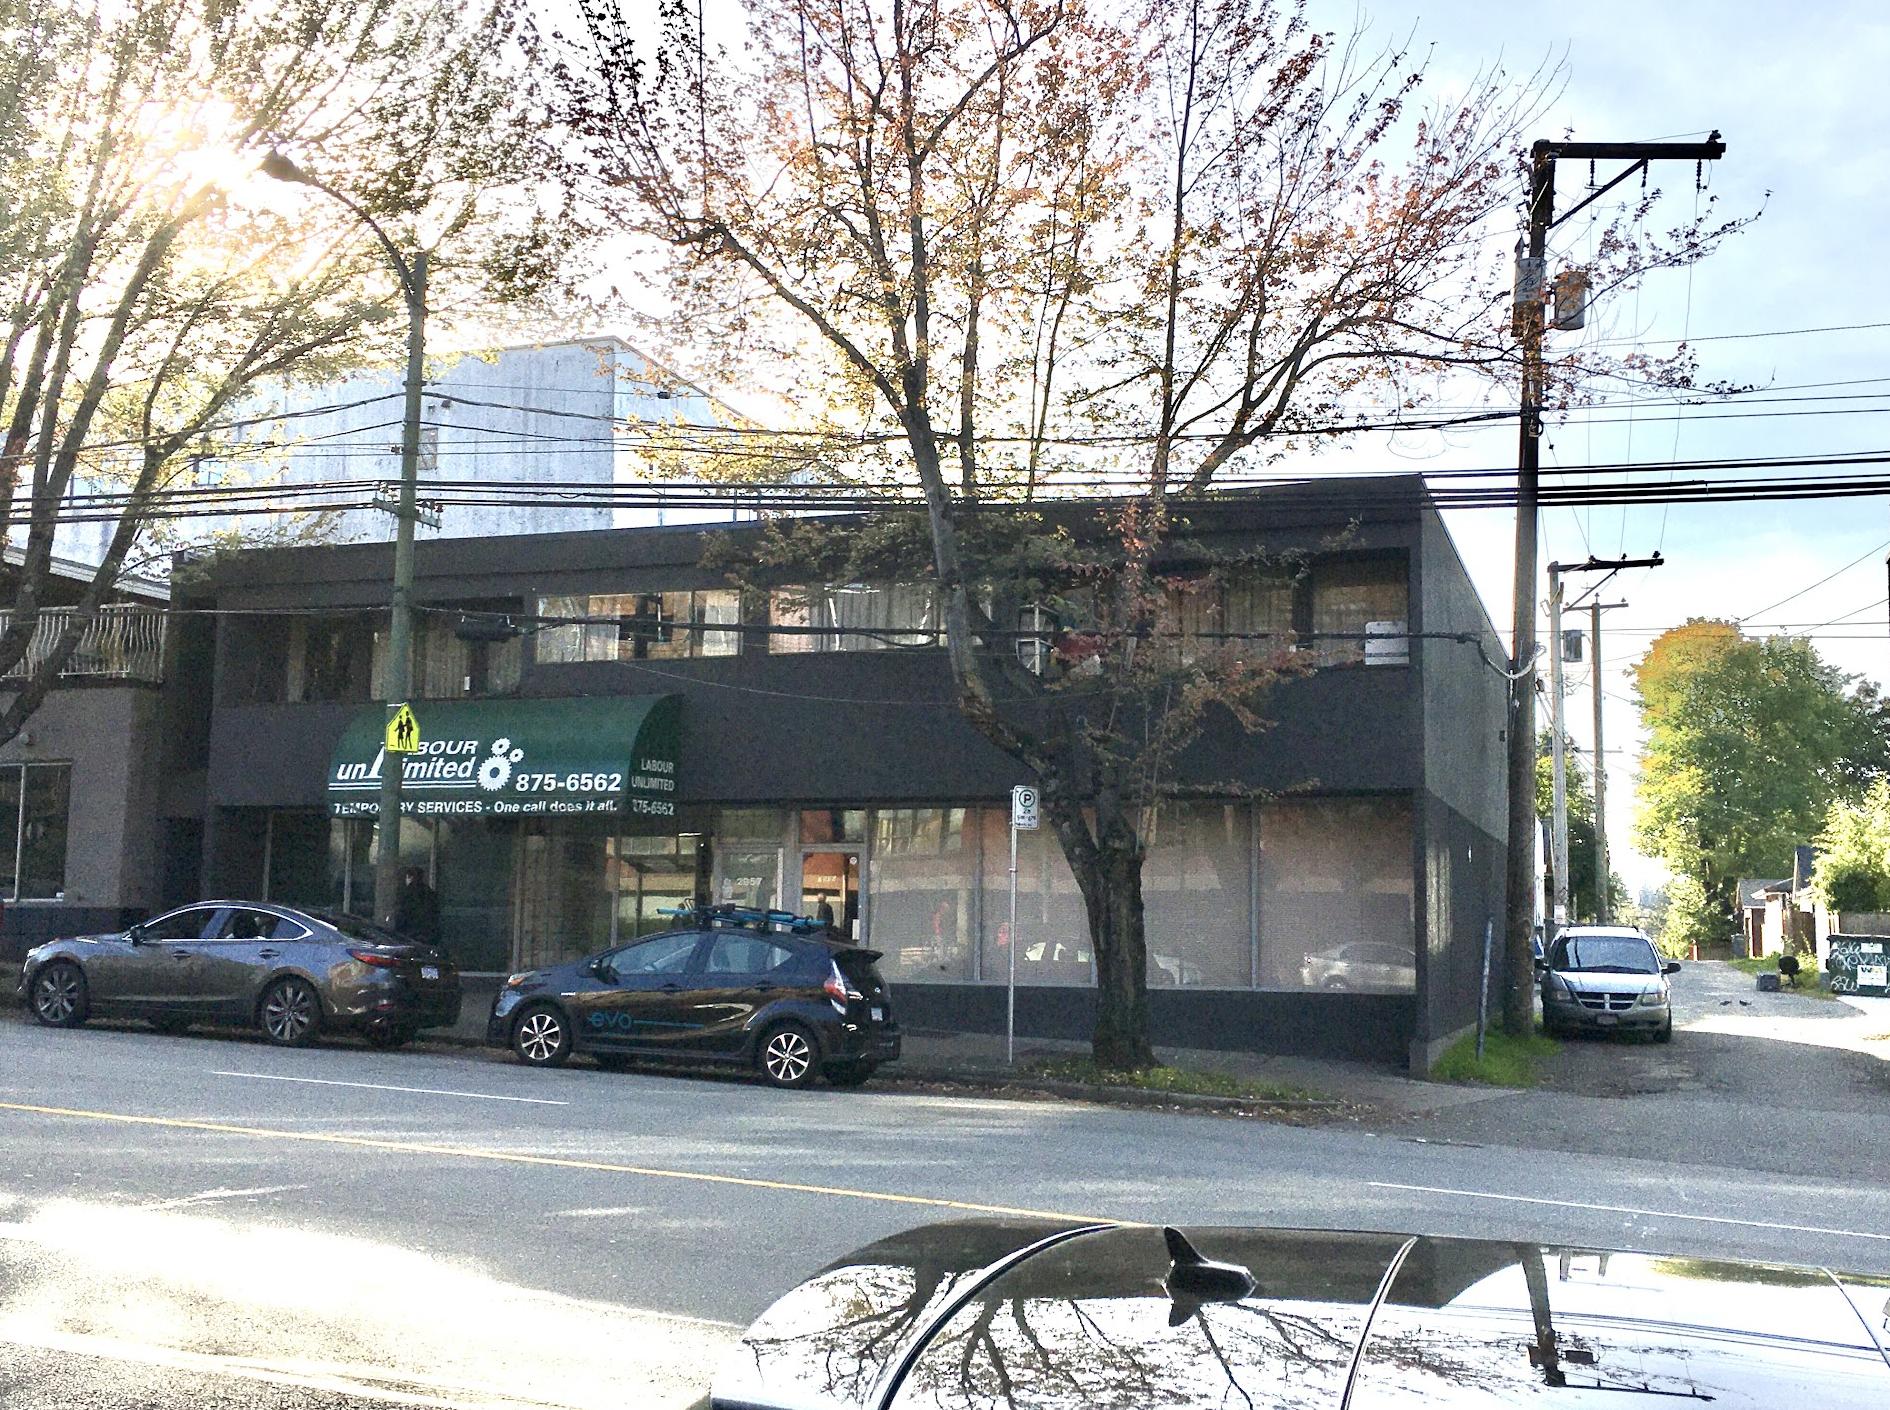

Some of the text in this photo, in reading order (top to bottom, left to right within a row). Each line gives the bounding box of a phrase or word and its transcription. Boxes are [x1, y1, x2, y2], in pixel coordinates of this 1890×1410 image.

[641, 758, 674, 774] LABOUR
[516, 773, 622, 792] 875-6562
[631, 775, 675, 791] UNLIMITED
[334, 802, 414, 814] TEMPORY
[417, 801, 483, 814] SERVICES
[493, 801, 521, 813] One
[523, 800, 546, 812] call
[550, 800, 582, 812] does
[585, 800, 594, 811] it
[588, 1011, 632, 1029] evo
